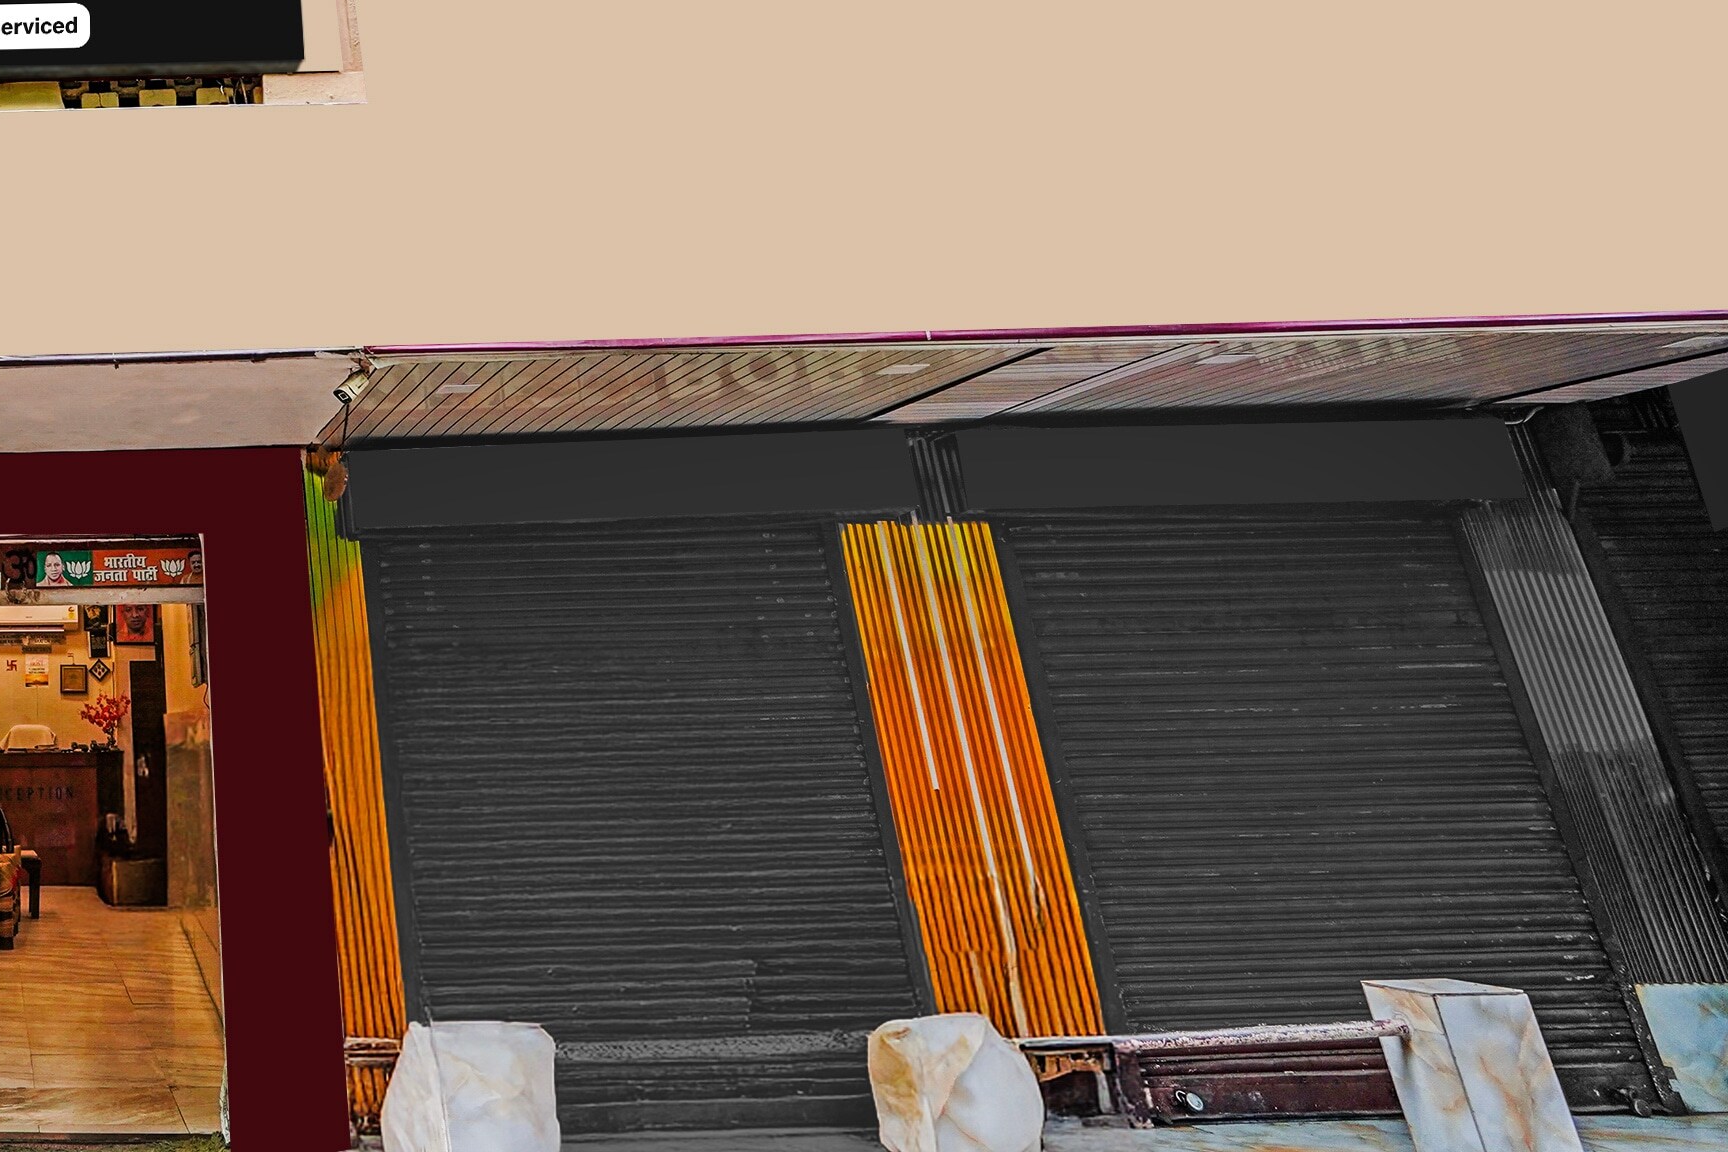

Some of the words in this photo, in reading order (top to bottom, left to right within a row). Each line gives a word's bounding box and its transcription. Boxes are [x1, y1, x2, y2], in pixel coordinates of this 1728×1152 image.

[104, 553, 147, 568] भारतीय
[93, 569, 129, 582] जनता
[132, 565, 159, 581] पार्टी
